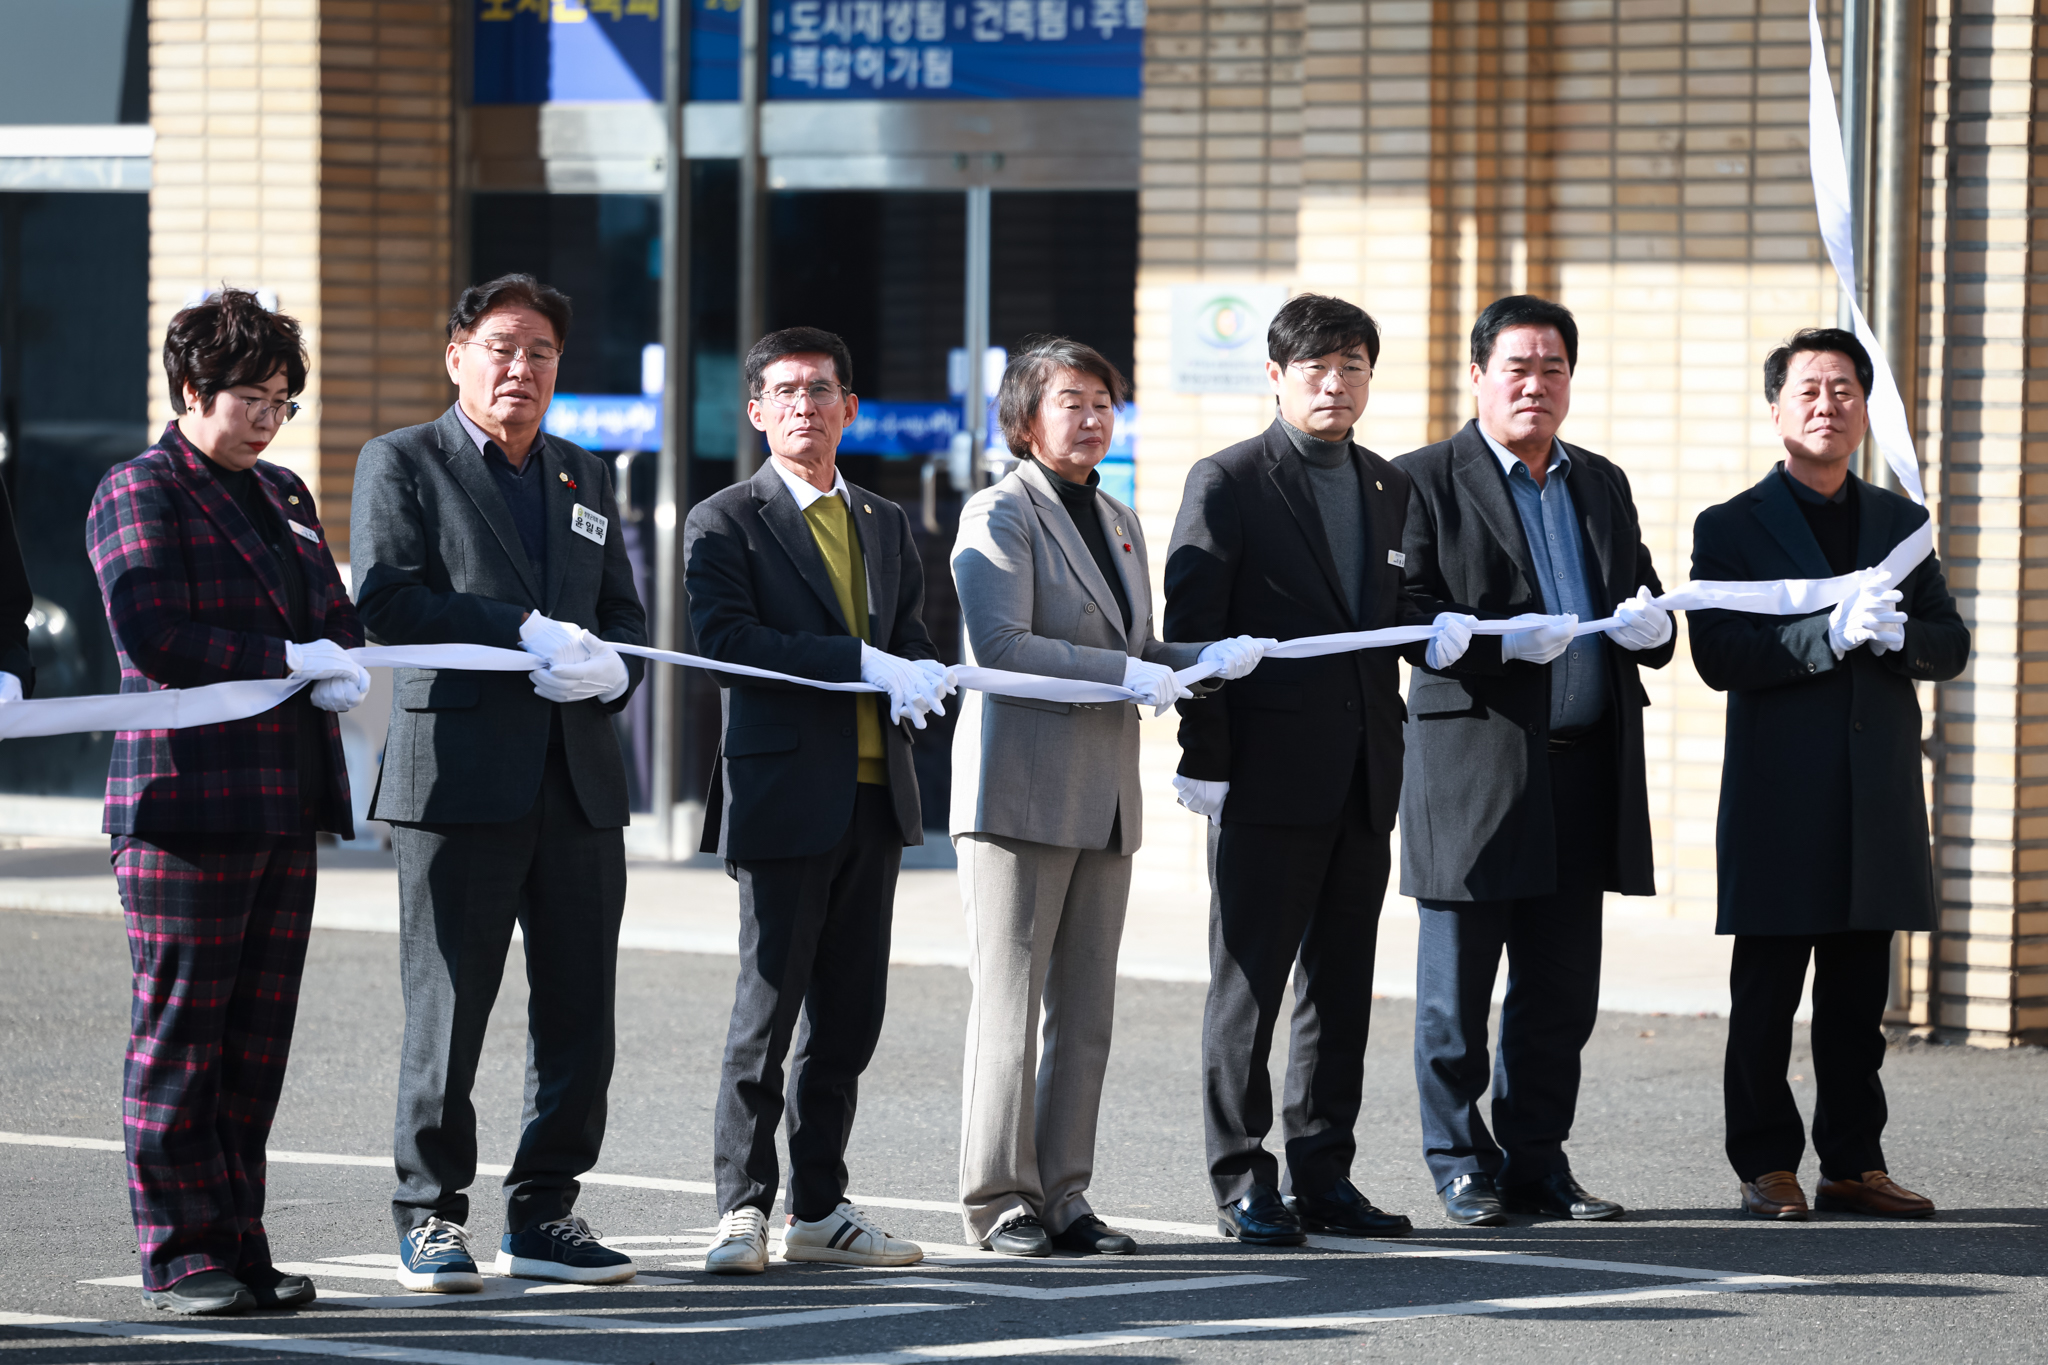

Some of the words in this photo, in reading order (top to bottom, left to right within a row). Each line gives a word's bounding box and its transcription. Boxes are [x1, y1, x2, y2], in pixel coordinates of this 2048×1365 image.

[789, 0, 946, 42] 도시재생팀
[972, 0, 1067, 41] 건축팀
[788, 46, 953, 89] 복합허가팀
